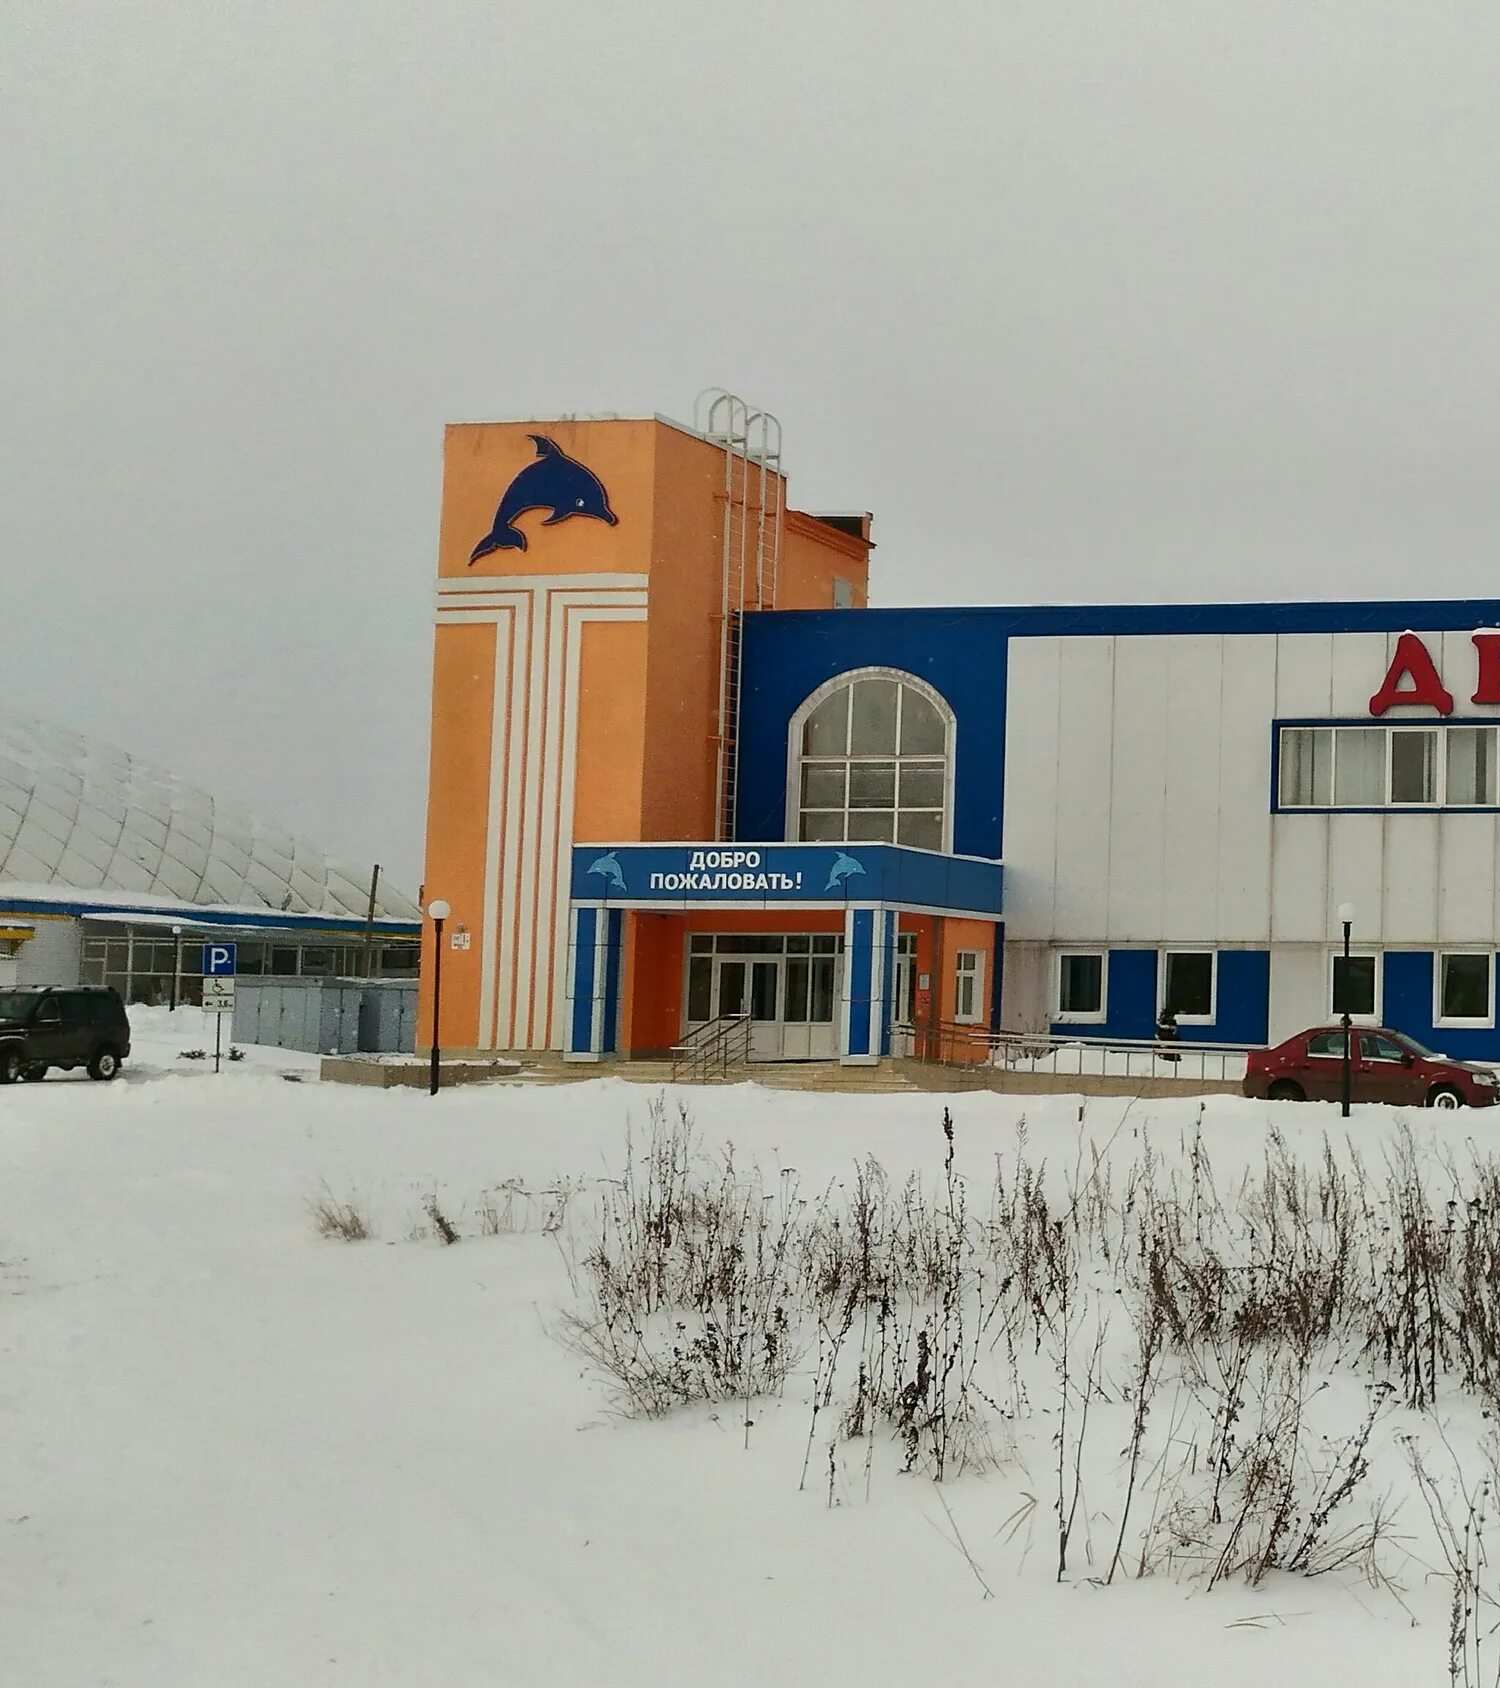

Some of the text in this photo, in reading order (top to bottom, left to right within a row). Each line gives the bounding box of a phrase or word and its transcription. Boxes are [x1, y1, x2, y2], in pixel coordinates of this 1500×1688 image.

[690, 851, 760, 871] ДОБРО
[650, 872, 802, 890] ПОЖАЛОВАТЬ!
[211, 947, 229, 973] P
